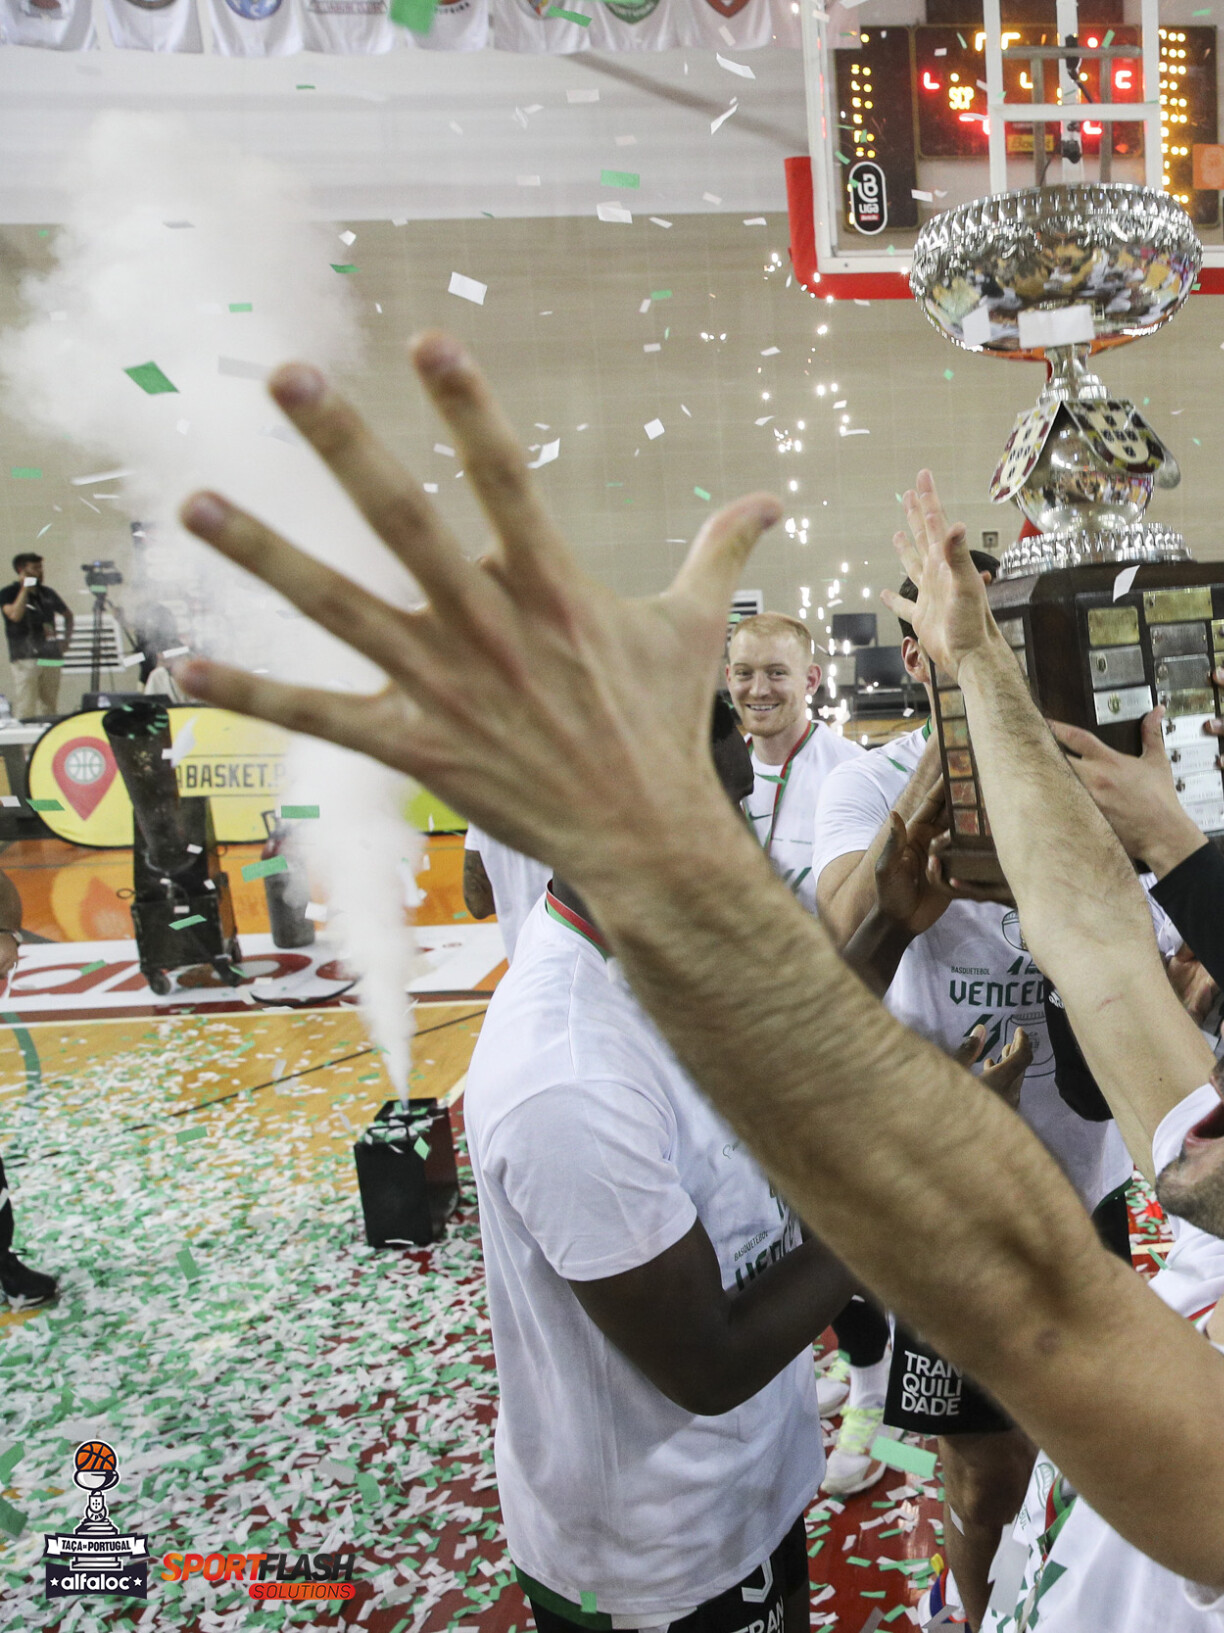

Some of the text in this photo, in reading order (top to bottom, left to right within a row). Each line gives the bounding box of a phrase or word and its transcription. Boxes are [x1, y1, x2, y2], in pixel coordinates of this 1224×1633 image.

[904, 1350, 962, 1378] TRAN
[902, 1372, 962, 1397] QUILI
[901, 1390, 961, 1416] DADE
